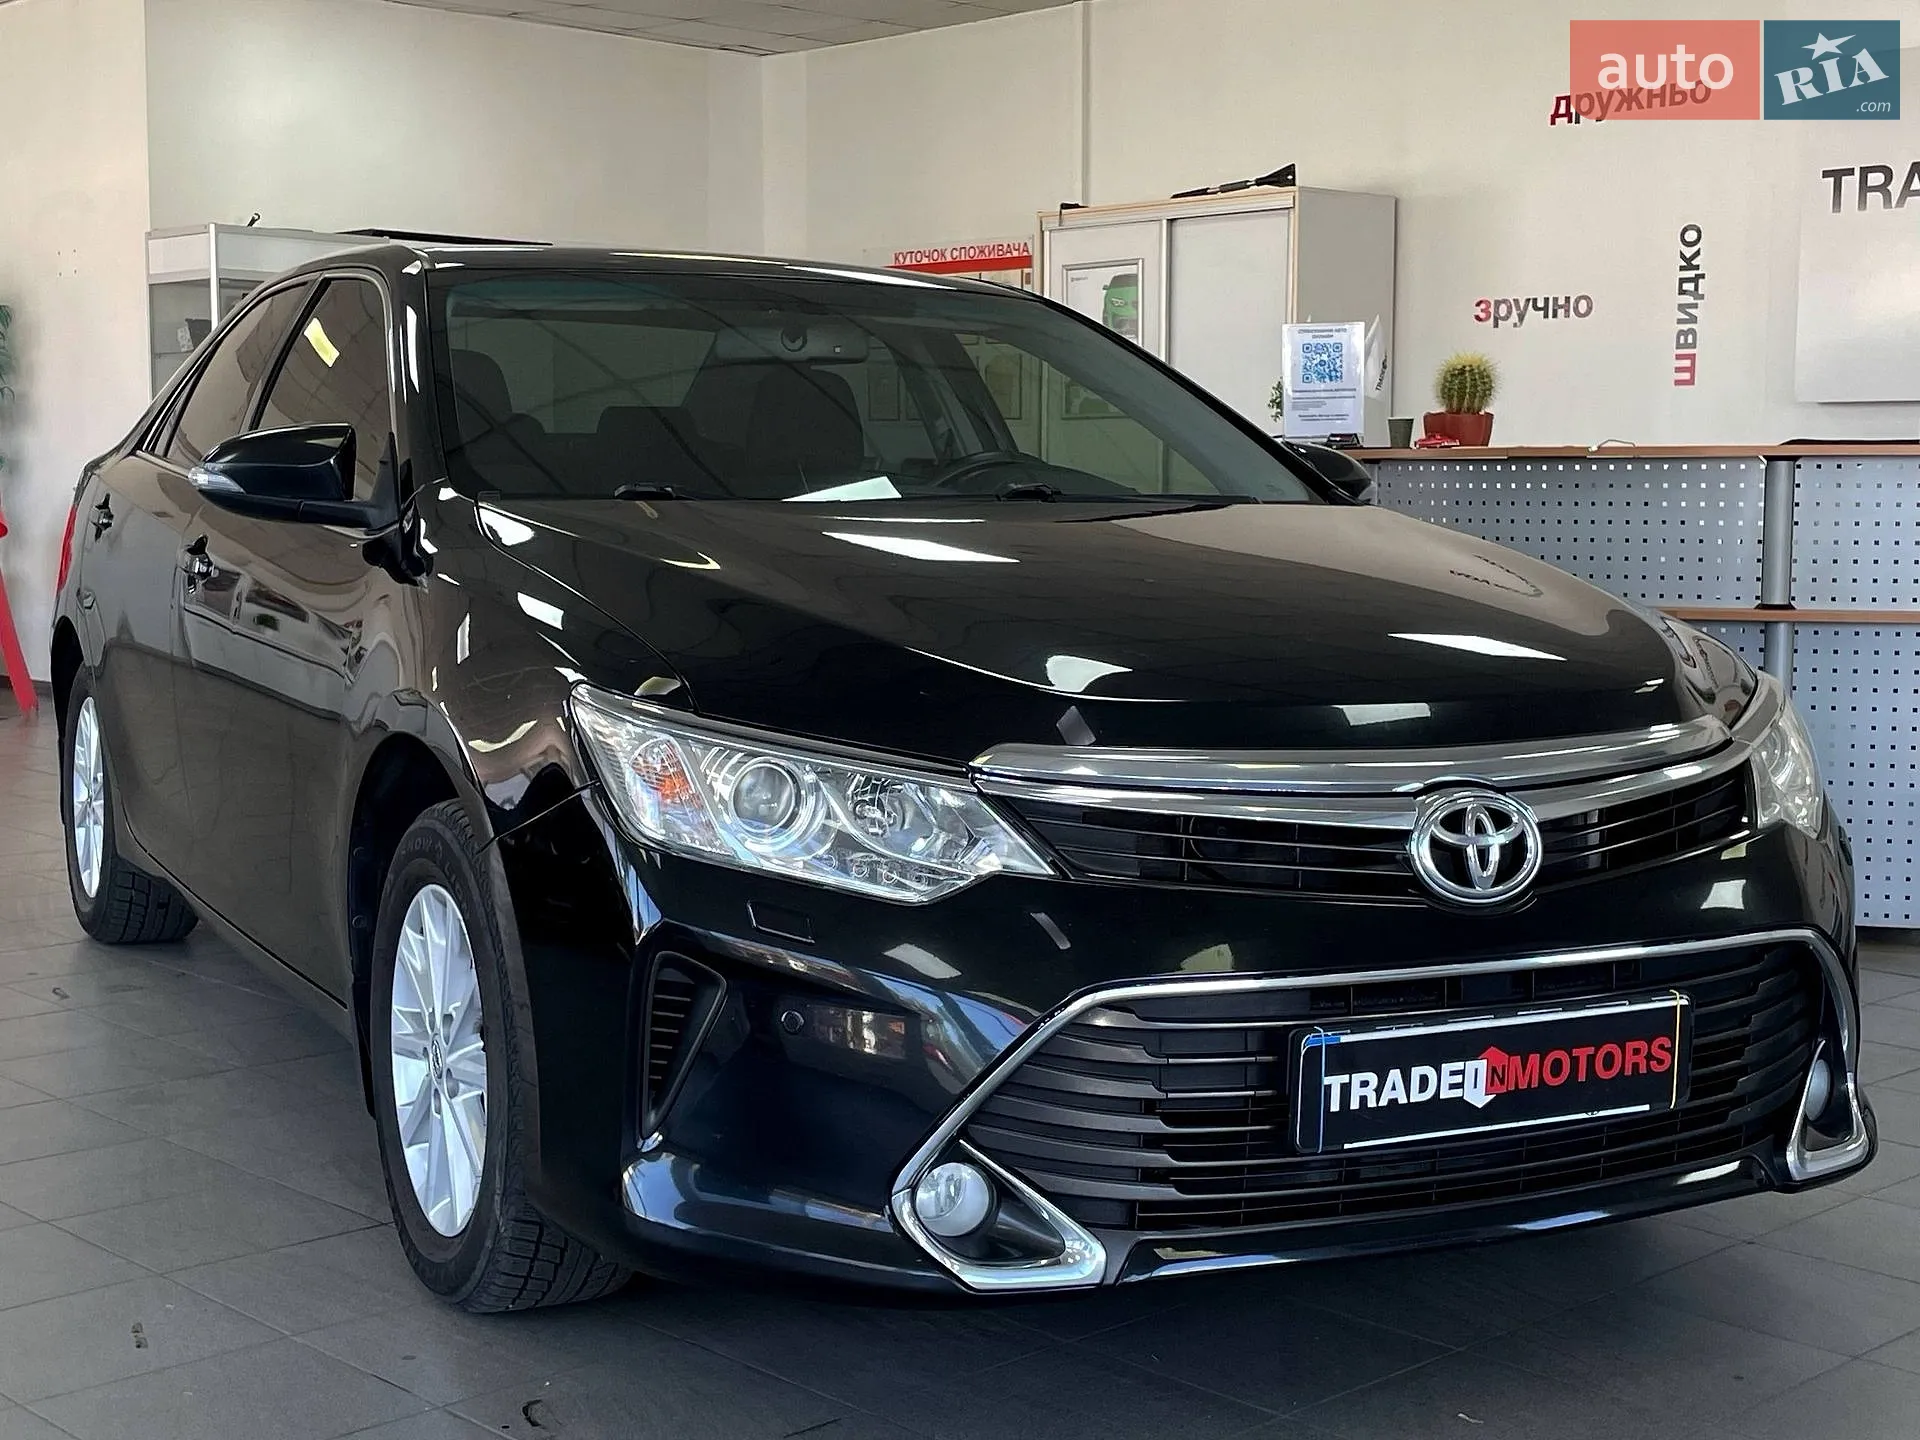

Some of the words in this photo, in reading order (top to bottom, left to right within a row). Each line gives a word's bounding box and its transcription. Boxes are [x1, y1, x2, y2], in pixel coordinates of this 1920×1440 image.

[894, 248, 949, 265] КУТОЧОК
[950, 241, 1030, 260] СПОЖИВАЧА
[1474, 294, 1594, 329] зручно
